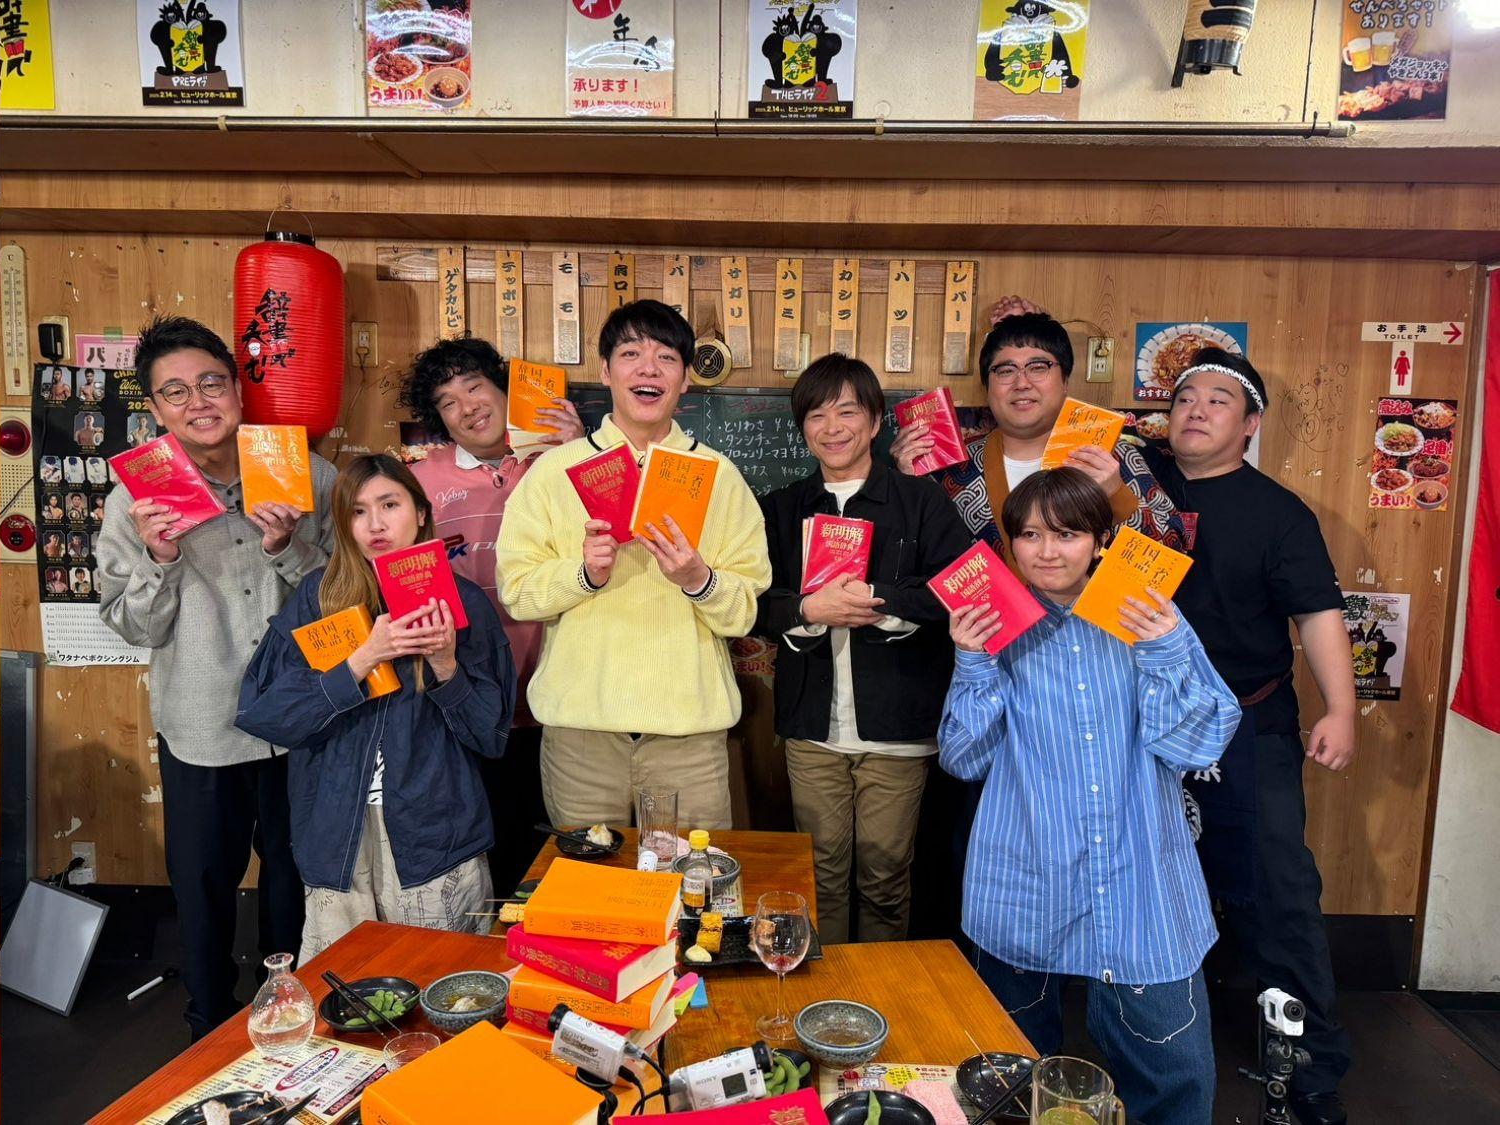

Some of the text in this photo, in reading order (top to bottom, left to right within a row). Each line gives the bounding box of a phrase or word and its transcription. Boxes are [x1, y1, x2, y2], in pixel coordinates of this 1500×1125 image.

[573, 78, 639, 93] 承ります！
[445, 267, 462, 329] ゲタカルビ
[502, 261, 518, 317] テッポウ
[558, 263, 574, 314] モモ
[613, 264, 629, 308] 肩ロー
[727, 267, 744, 319] サガリ
[781, 269, 798, 321] ハラミ
[838, 268, 854, 322] カシラ
[894, 270, 911, 322] ハツ
[952, 271, 969, 323] レバー
[1377, 324, 1427, 333] お手洗
[1138, 388, 1171, 399] おすすめ
[1369, 492, 1412, 507] うまい！
[821, 522, 865, 545] 新明解
[943, 552, 989, 594] 新明解
[58, 652, 140, 664] ワタナベボクシングジム
